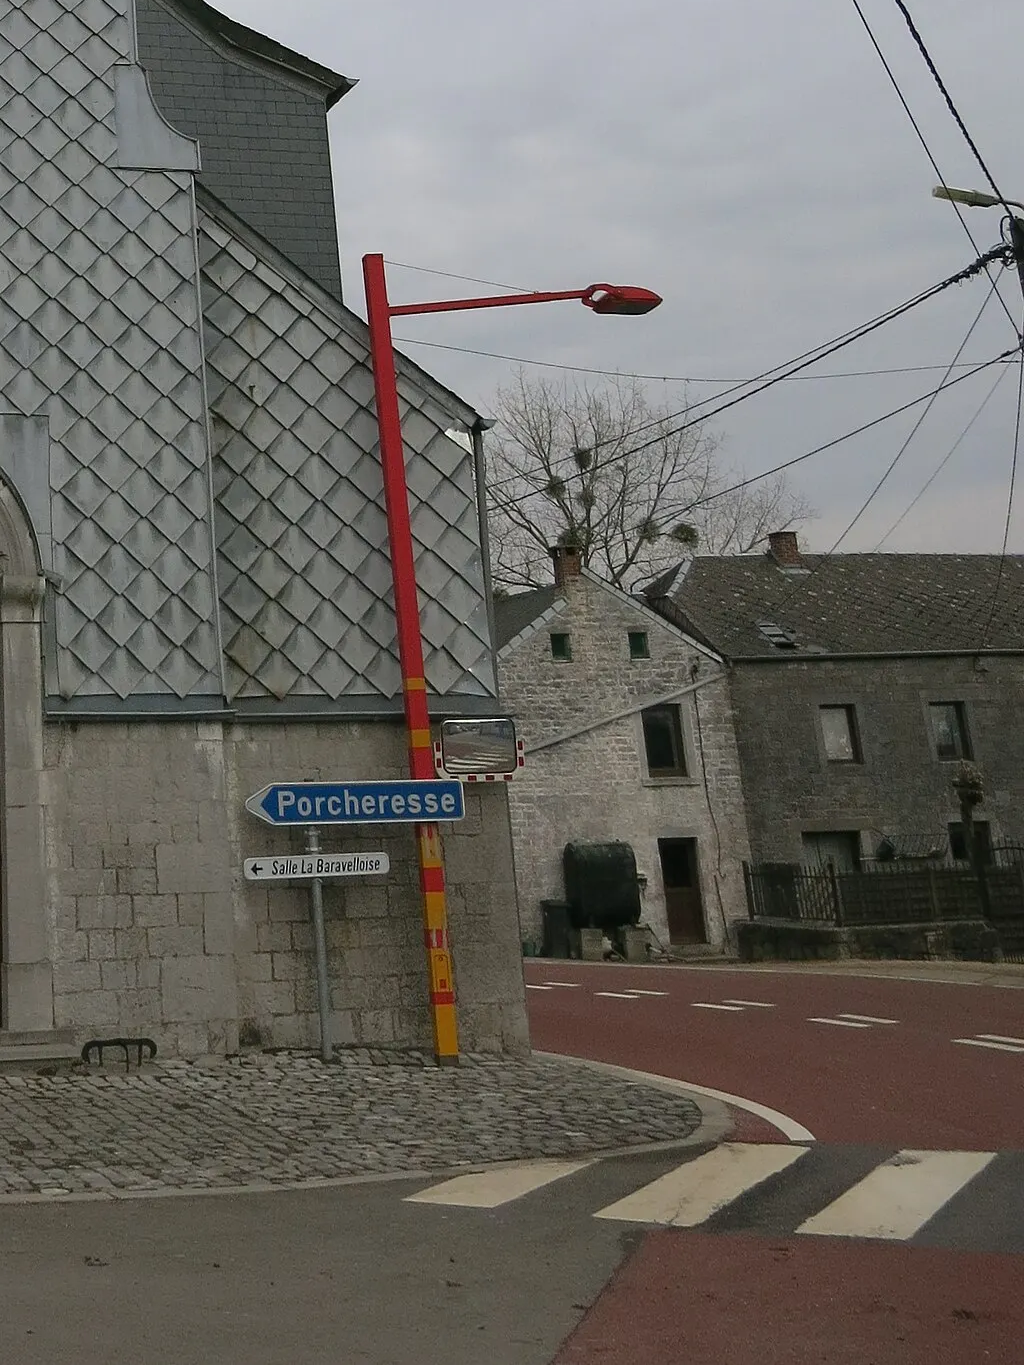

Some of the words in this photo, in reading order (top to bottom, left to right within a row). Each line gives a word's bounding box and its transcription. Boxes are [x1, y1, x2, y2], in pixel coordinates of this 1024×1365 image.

[277, 789, 455, 817] Porcheresse
[272, 860, 297, 875] Salle
[301, 859, 313, 874] La
[316, 857, 380, 873] Baravelloise
